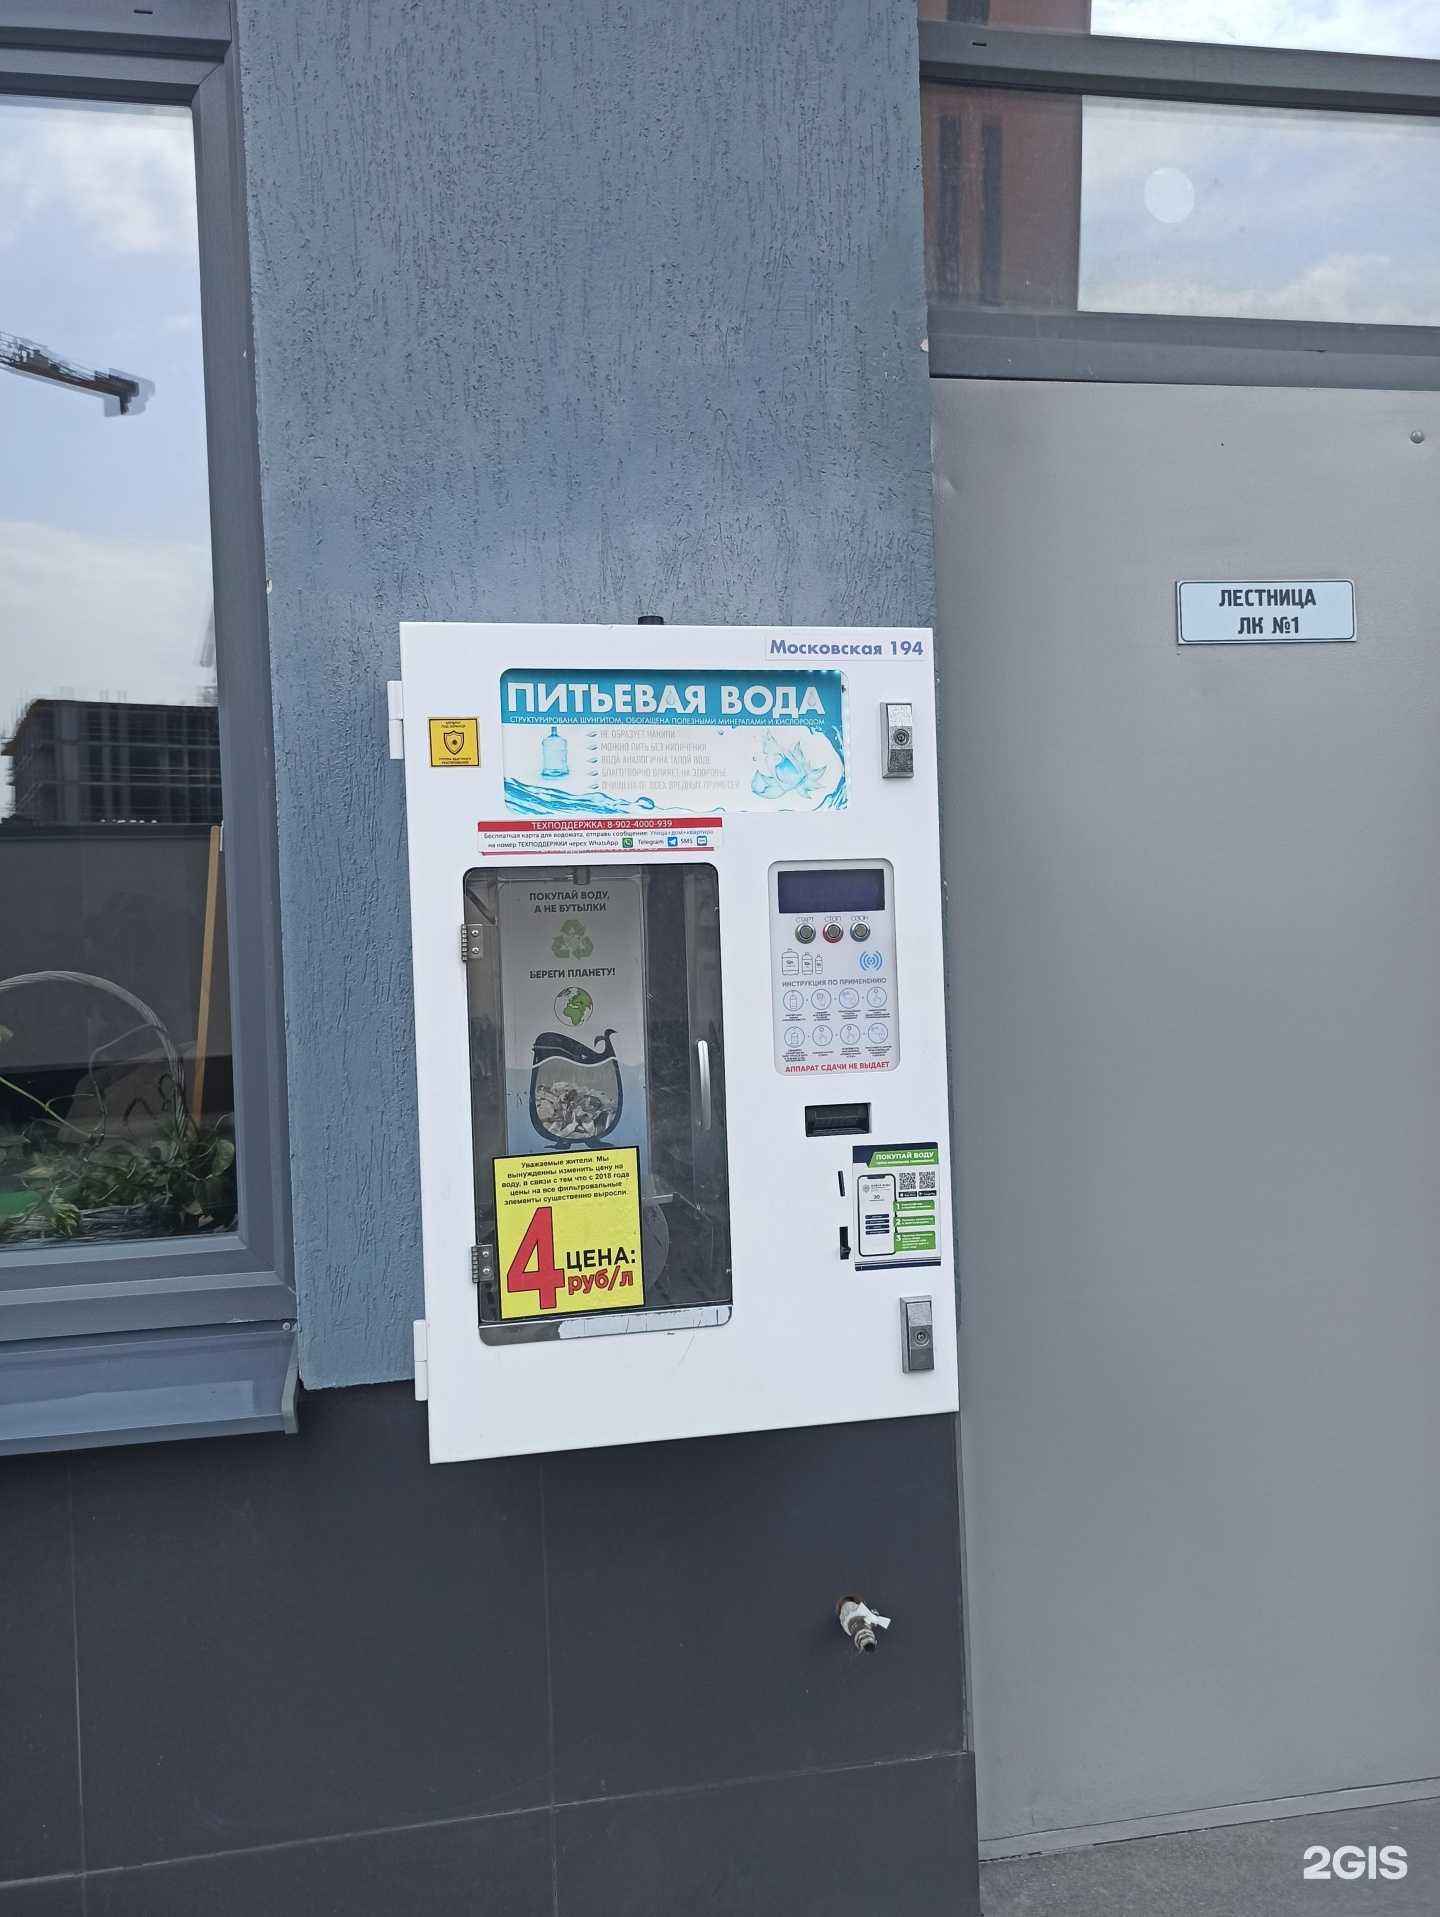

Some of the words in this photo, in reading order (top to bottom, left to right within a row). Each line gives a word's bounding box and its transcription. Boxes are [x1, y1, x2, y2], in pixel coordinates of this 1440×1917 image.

[1218, 588, 1317, 609] ЛЕСТНИЦА
[1238, 616, 1264, 635] ЛК
[1271, 616, 1299, 634] №1
[769, 639, 883, 656] Московская
[890, 640, 924, 656] 194
[507, 682, 706, 715] ПИТЬЕВАЯ
[720, 685, 826, 720] ВОДА
[671, 717, 717, 725] ПОЛЕЗНЫМИ
[718, 717, 766, 726] МИНЕРАЛАМИ
[775, 717, 825, 727] КИСЛОРОДОМ
[531, 820, 606, 831] ТЕХПОДДЕРЖКА:
[607, 819, 673, 829] 8-902-4000-939
[521, 832, 540, 840] карта
[496, 842, 517, 850] номер
[518, 841, 568, 849] ТЕХПОДДЕРЖКИ
[588, 840, 619, 849] WhatsApp
[637, 838, 664, 847] Telegram
[529, 890, 578, 901] ПОКУПАЙ
[580, 890, 610, 901] ВОДУ,
[534, 904, 542, 913] А
[543, 904, 557, 913] НЕ
[559, 902, 607, 913] БУТЫЛКИ
[529, 968, 565, 979] БЕРЕГИ
[567, 967, 616, 978] ПЛАНЕТУ!
[782, 979, 827, 988] ИНСТРУКЦИЯ
[827, 978, 839, 986] ПО
[839, 977, 887, 986] ПРИМЕНЕНИЮ
[785, 1064, 819, 1073] АППАРАТ
[820, 1062, 847, 1072] СДАЧИ
[848, 1062, 858, 1070] НЕ
[860, 1060, 890, 1070] ВЫДАЕТ
[521, 1159, 564, 1169] Уважаемые
[596, 1155, 610, 1163] Мы
[875, 1151, 912, 1161] ПОКУПАЙ
[913, 1151, 934, 1159] ВОДУ
[558, 1166, 594, 1175] изменить
[595, 1164, 613, 1172] цену
[510, 1189, 530, 1197] цены
[557, 1181, 623, 1194] фильтровальные
[503, 1197, 542, 1206] элементы
[543, 1192, 592, 1204] существенно
[507, 1206, 566, 1310] 4
[566, 1246, 636, 1272] ЦЕНА:
[567, 1264, 634, 1295] руб/л
